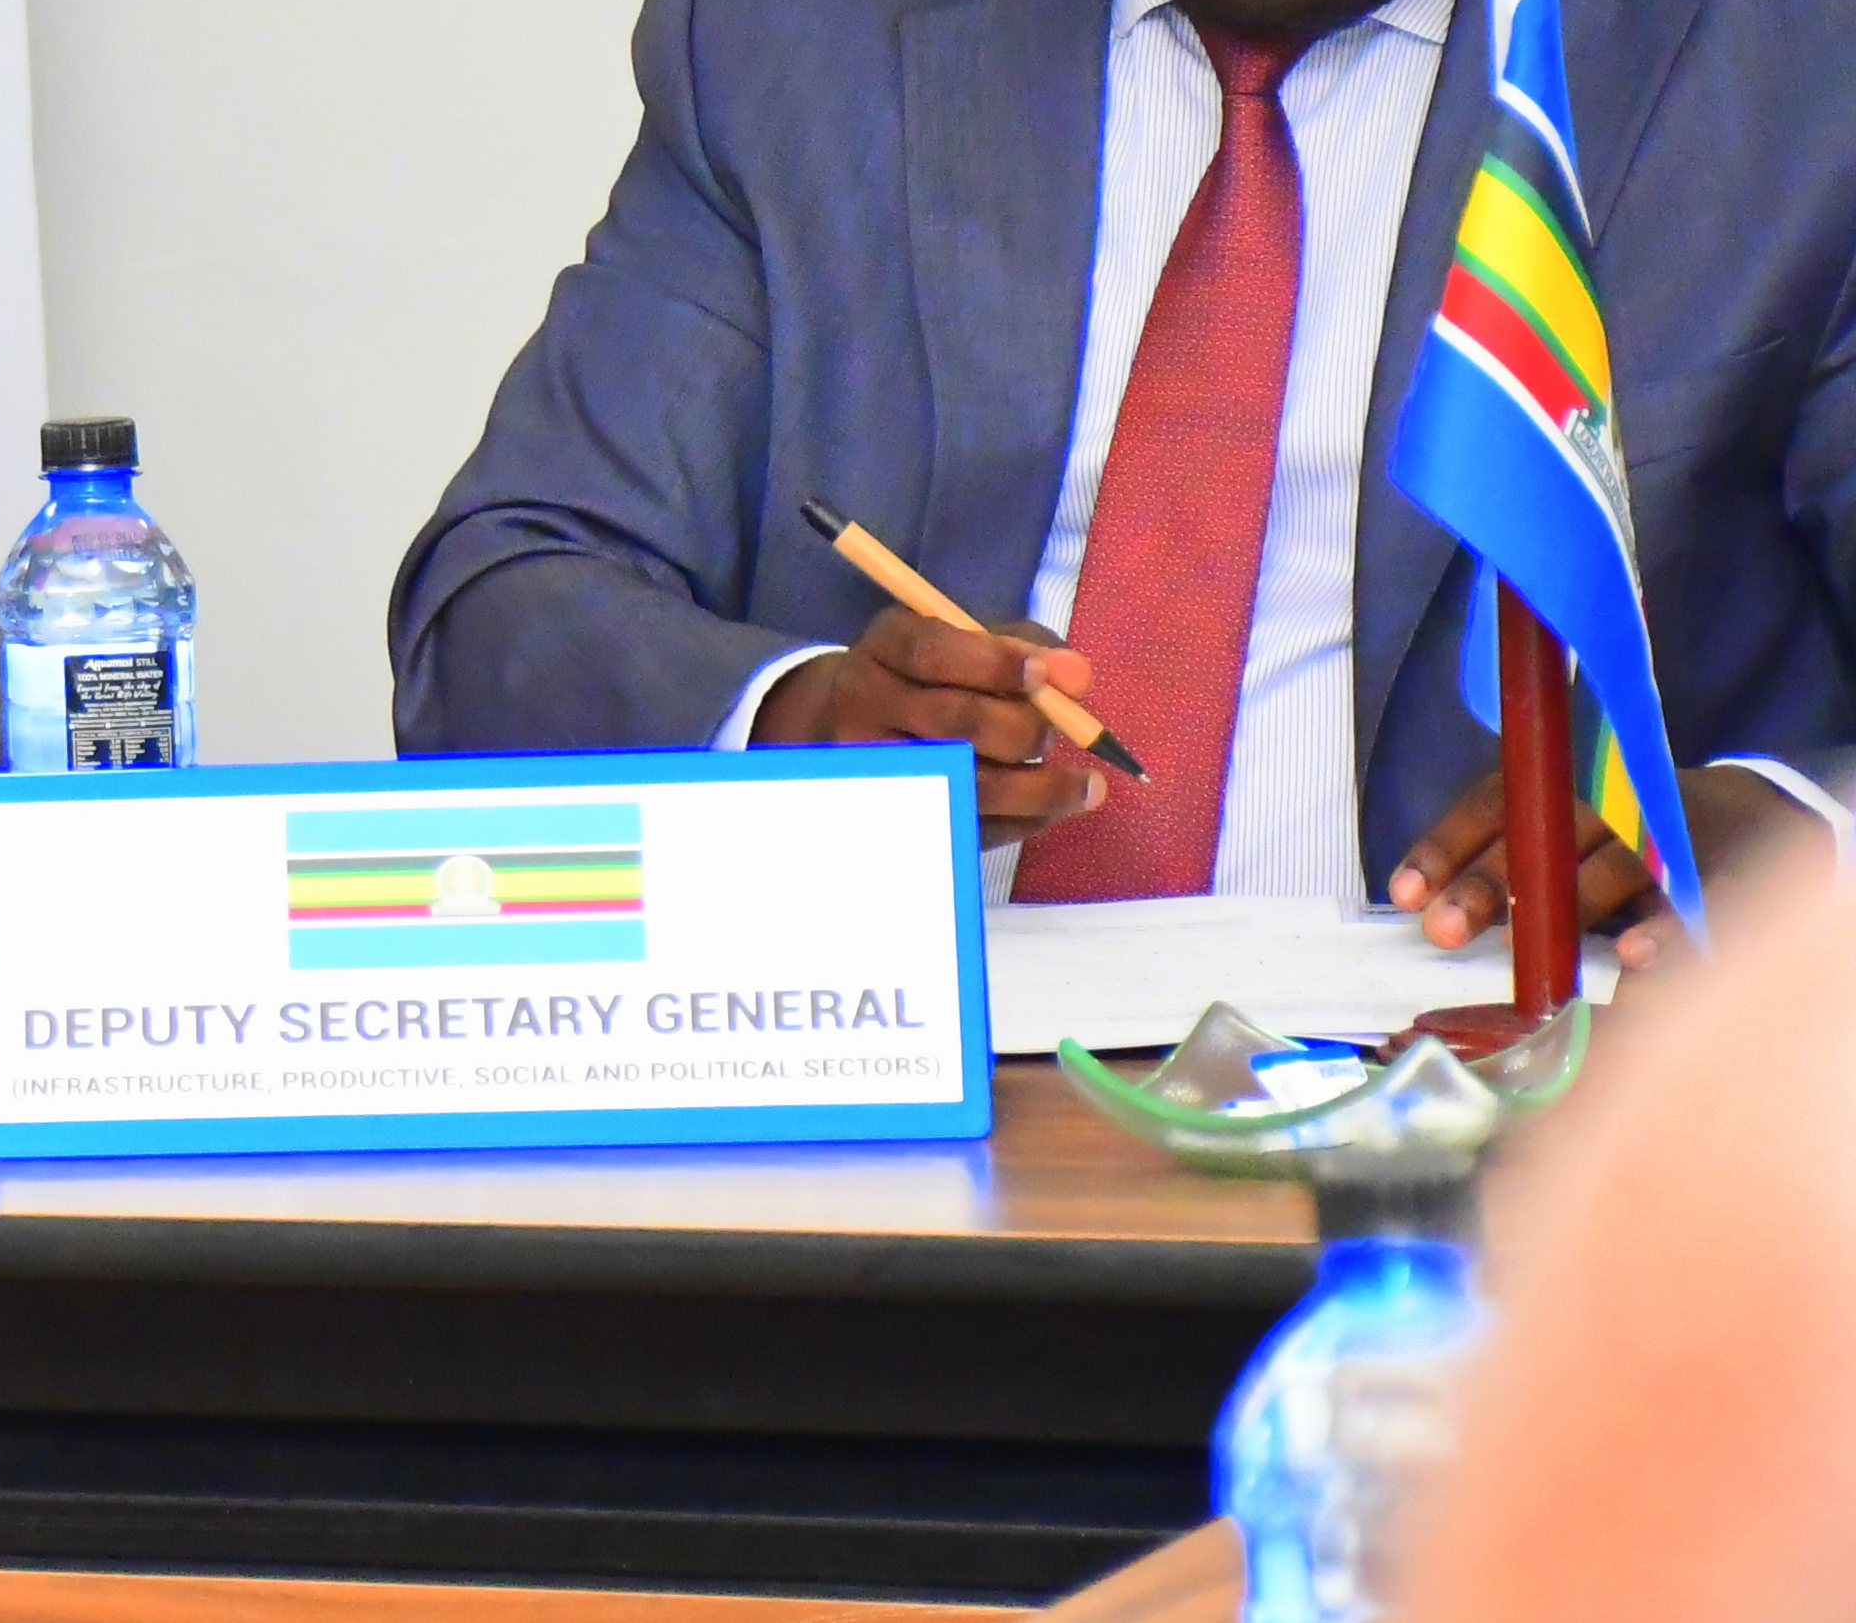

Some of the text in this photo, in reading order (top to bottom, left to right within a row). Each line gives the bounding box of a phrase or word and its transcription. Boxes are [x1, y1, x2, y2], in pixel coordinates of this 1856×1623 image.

[135, 657, 158, 668] STILL
[23, 987, 927, 1051] DEPUTY SECRETARY GENERAL
[11, 1055, 943, 1098] (INFRASTRUCTURE, PRODUCTIVE, SOCIAL AND POLITICAL SECTORS)
